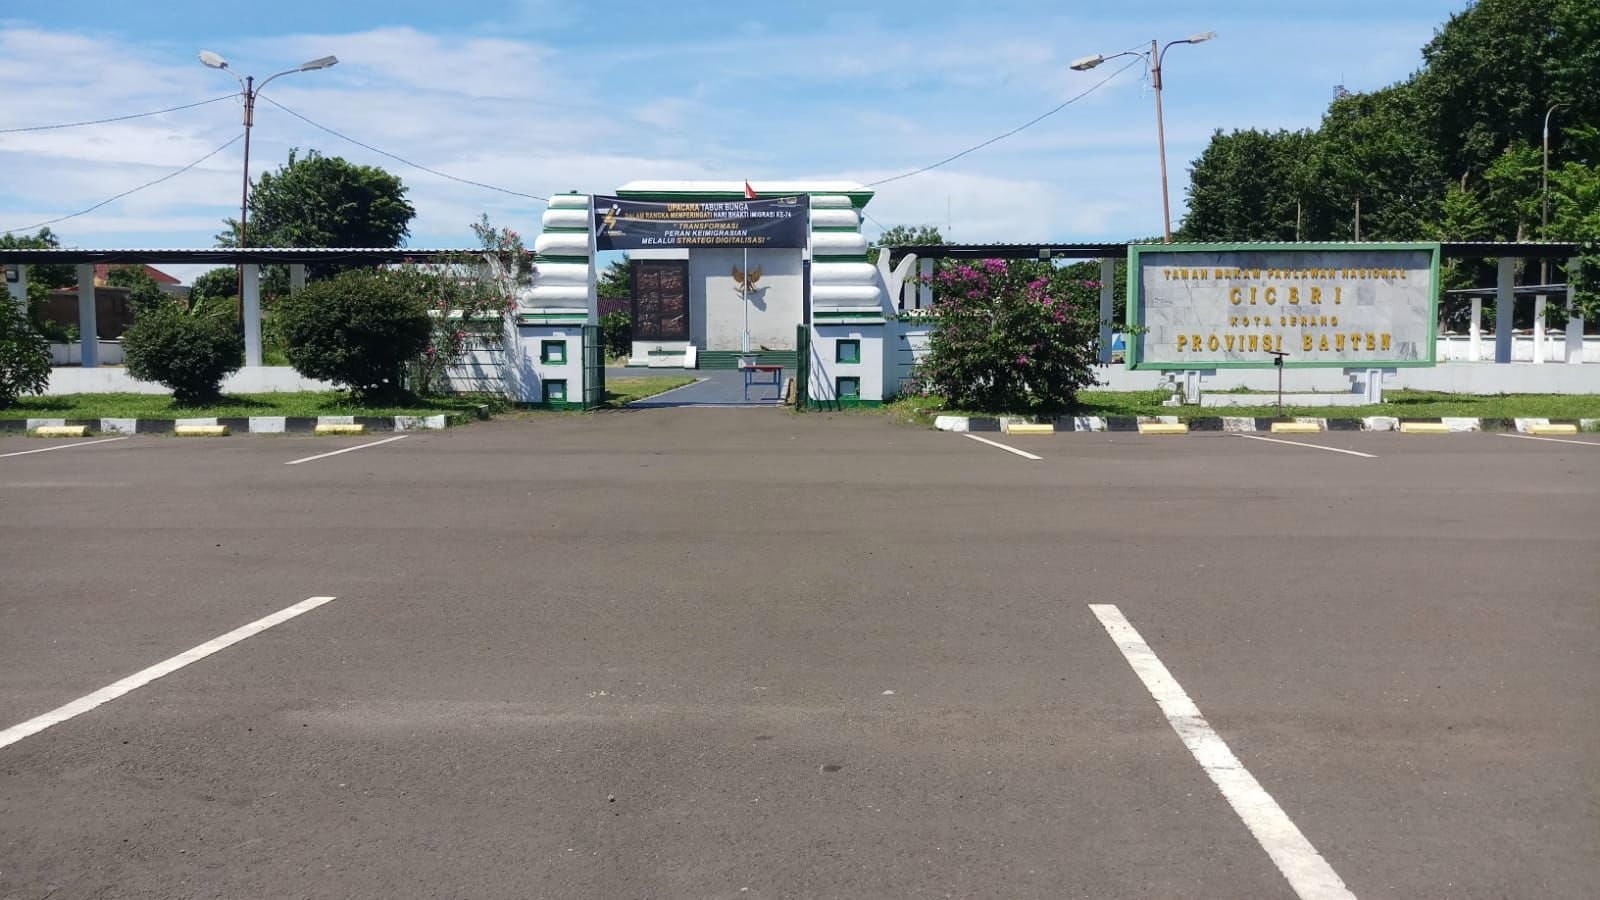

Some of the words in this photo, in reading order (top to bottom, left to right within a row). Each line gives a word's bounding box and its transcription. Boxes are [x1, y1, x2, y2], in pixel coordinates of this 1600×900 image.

[667, 203, 699, 212] UPACARA
[701, 203, 724, 211] TABUR
[725, 203, 749, 211] BUNGA
[641, 237, 676, 245] MELALUI
[1164, 269, 1208, 280] TAMAN
[1215, 269, 1260, 280] MAKAM
[1342, 268, 1406, 279] NASIONAL
[1230, 287, 1342, 305] CICERI
[1231, 316, 1272, 327] KOTA
[1280, 316, 1338, 327] SERANG
[1177, 335, 1282, 352] PROVINSI
[1303, 333, 1391, 352] BANTEN
